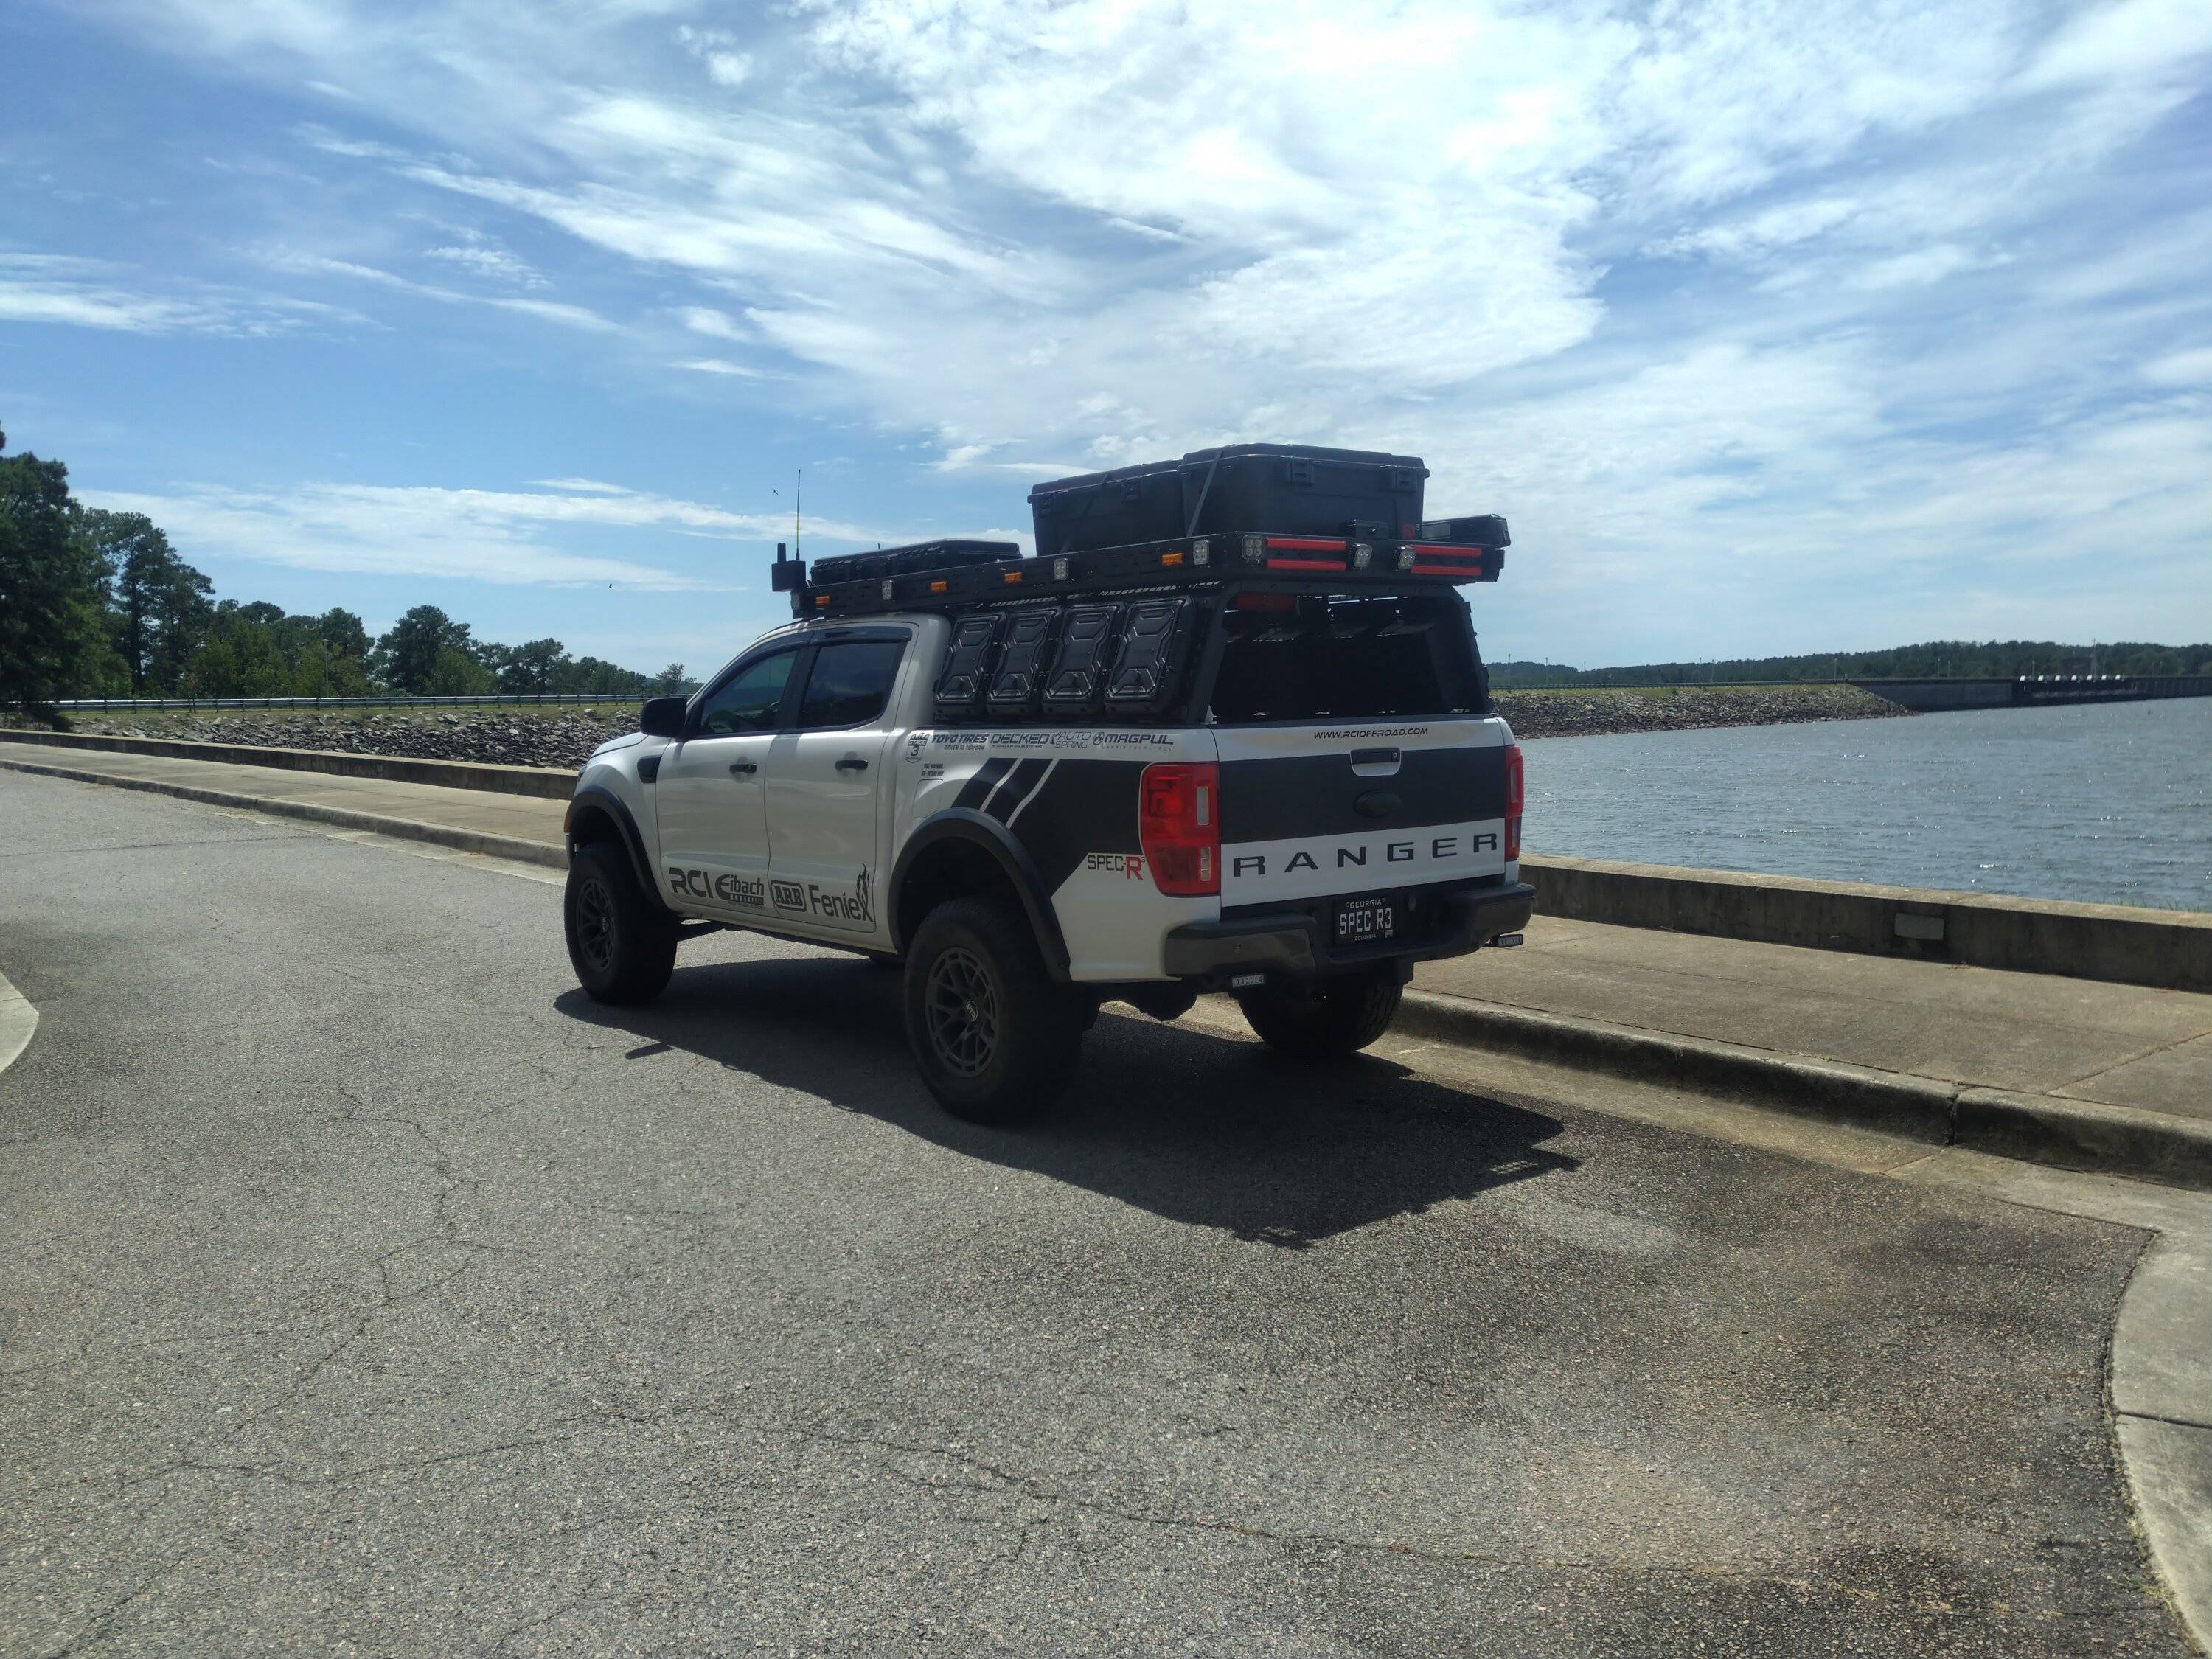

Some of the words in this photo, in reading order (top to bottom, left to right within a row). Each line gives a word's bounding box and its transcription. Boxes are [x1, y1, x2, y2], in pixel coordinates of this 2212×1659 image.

[932, 734, 960, 743] TOYO
[961, 734, 990, 743] TIRES
[990, 733, 1050, 744] DECKED
[1057, 731, 1091, 740] AUTO
[1314, 728, 1428, 739] WWW.RCIOFFROAD.COM
[1055, 741, 1088, 749] SPRING
[1105, 734, 1174, 745] MAGPUL
[1234, 833, 1497, 877] RANGER
[669, 867, 714, 898] RCI
[715, 874, 765, 900] Eibach
[774, 886, 804, 906] ARB
[1349, 899, 1382, 908] GEORGIA
[1340, 911, 1371, 935] SPEC
[1377, 908, 1391, 929] R3
